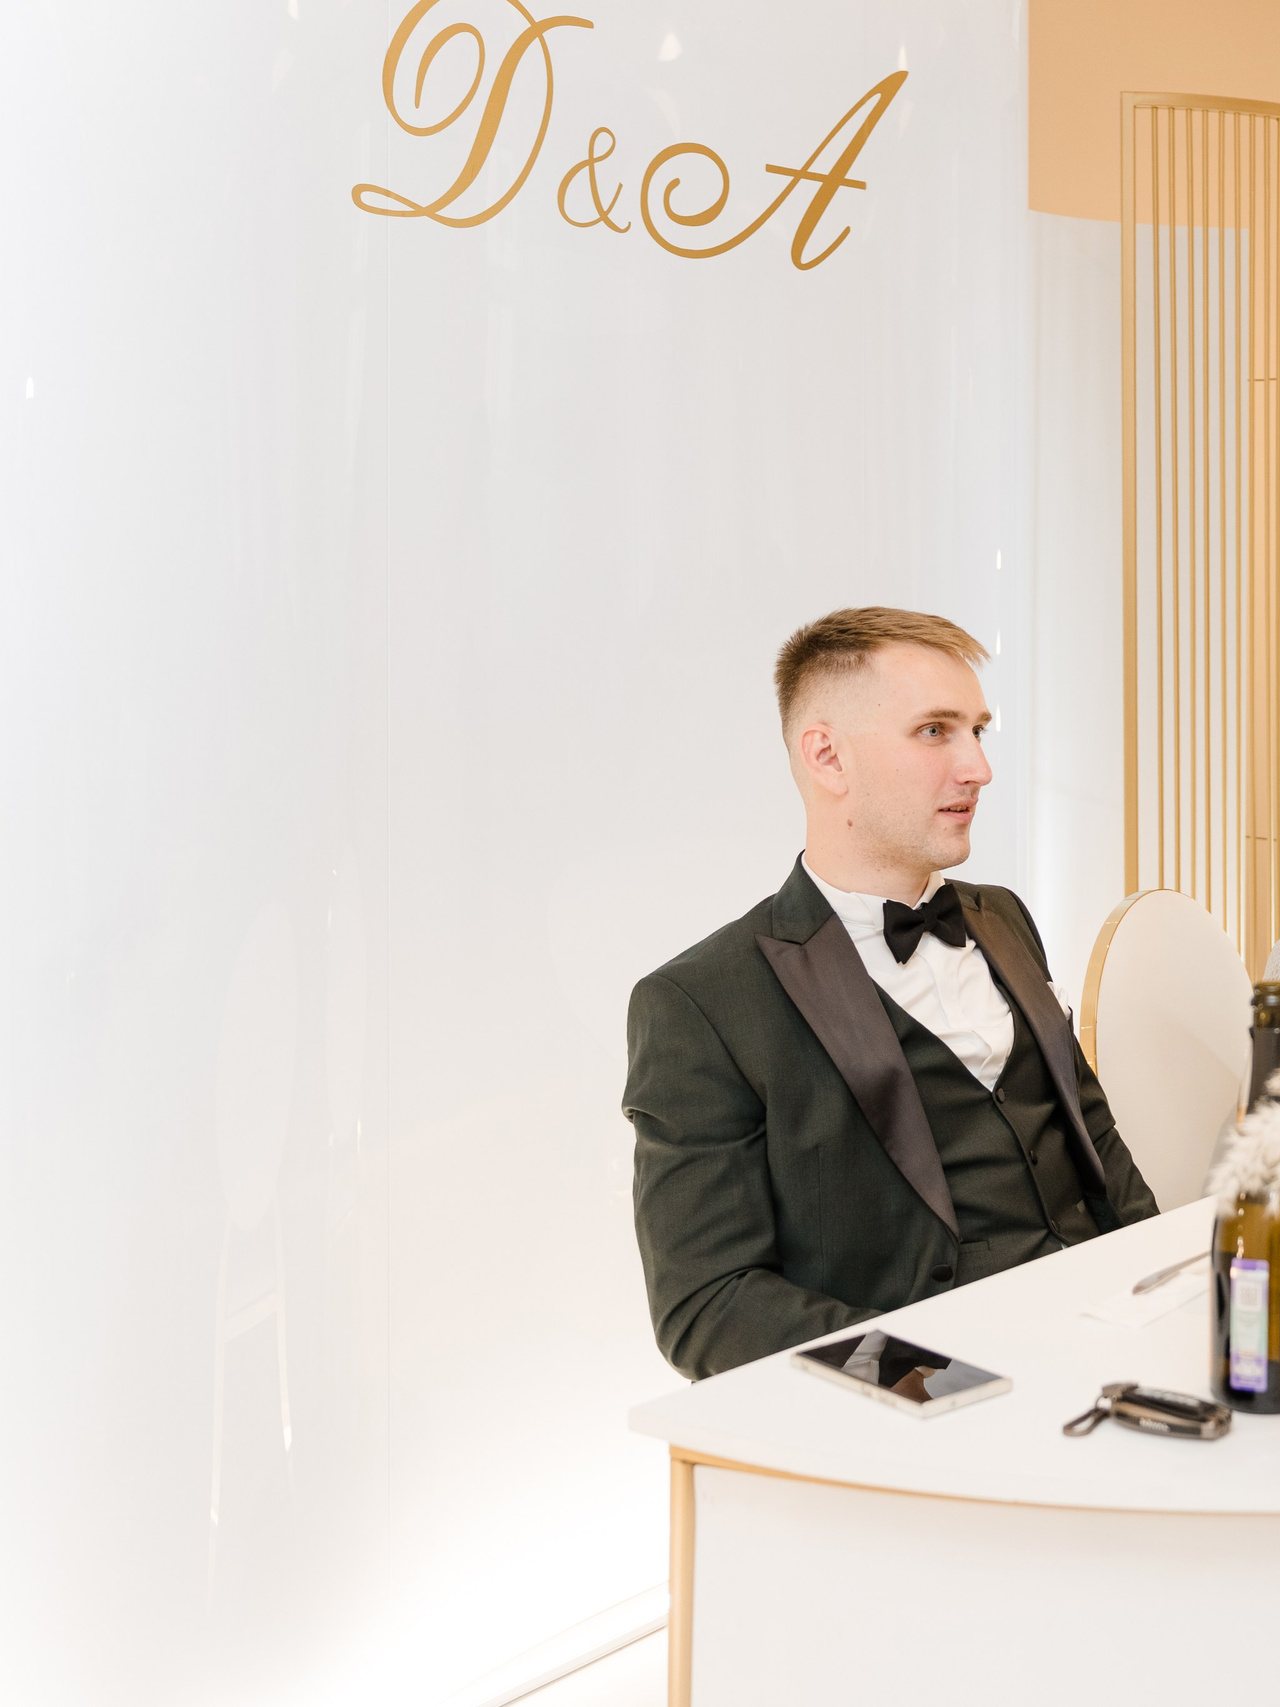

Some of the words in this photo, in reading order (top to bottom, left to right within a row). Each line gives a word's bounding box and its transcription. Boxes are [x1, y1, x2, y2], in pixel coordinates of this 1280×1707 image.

[352, 0, 595, 229] D
[557, 126, 631, 234] &
[640, 70, 910, 271] A
